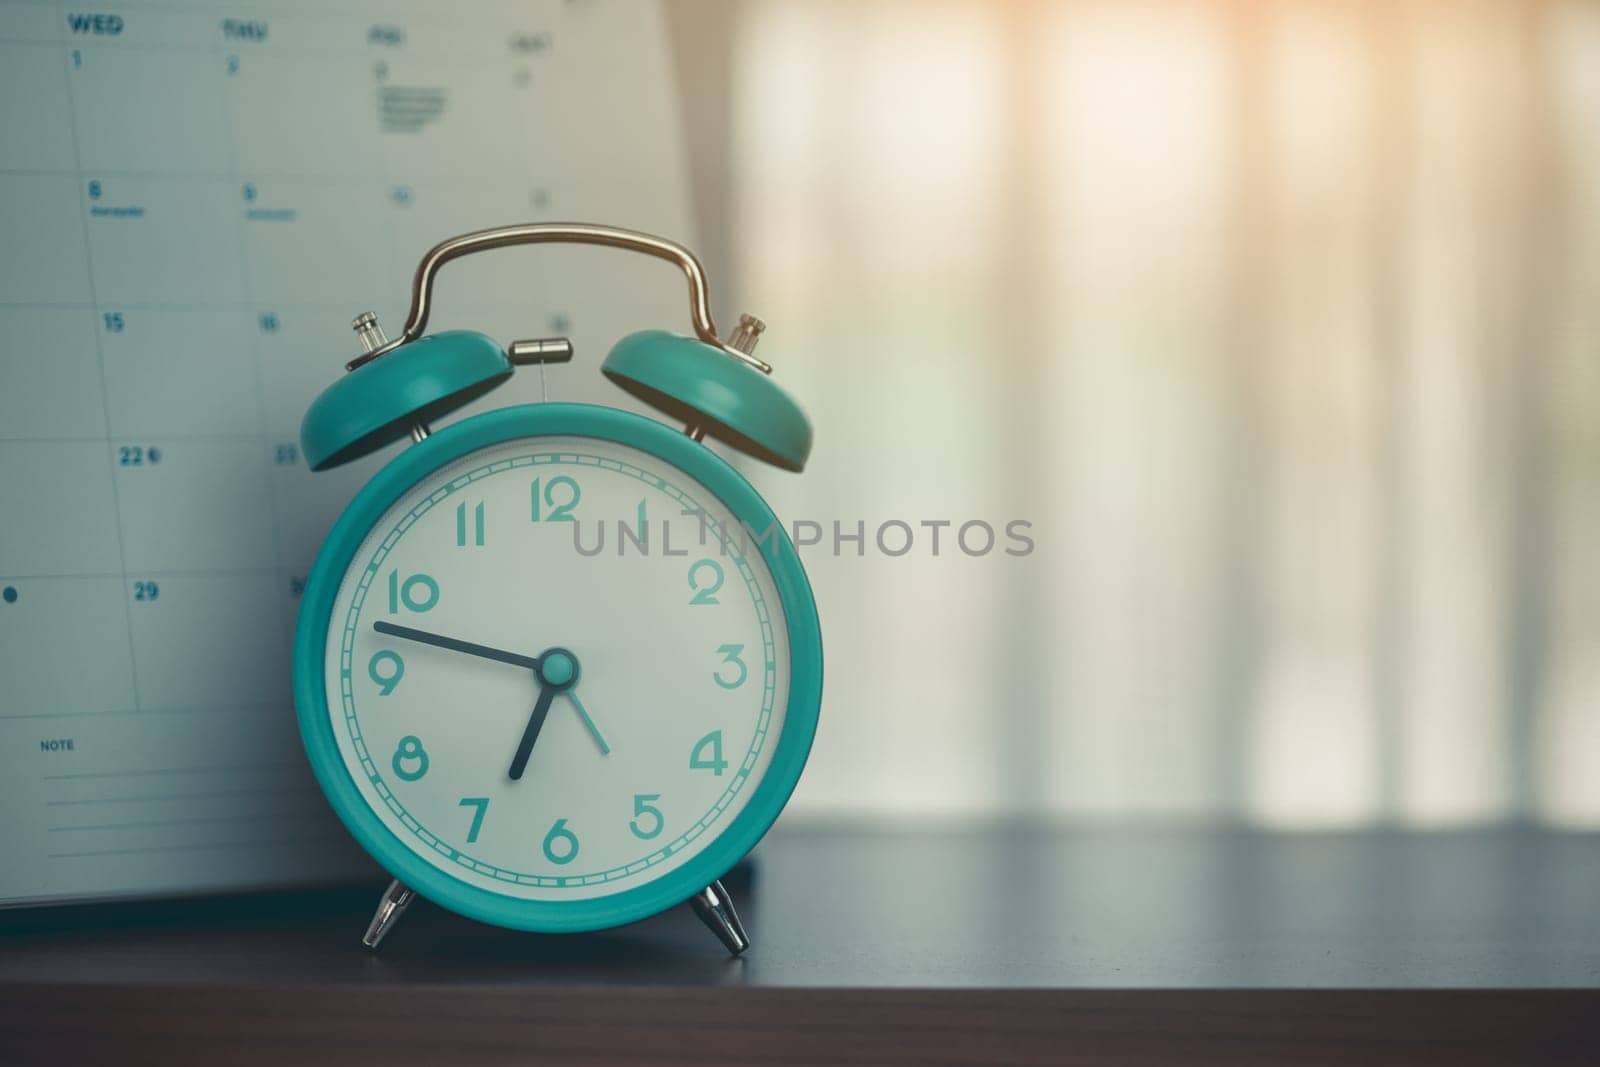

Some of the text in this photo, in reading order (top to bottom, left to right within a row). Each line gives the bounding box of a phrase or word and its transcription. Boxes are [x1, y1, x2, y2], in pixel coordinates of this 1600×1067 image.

[68, 14, 124, 35] WED
[89, 181, 102, 199] 8
[104, 313, 125, 332] 15
[120, 447, 143, 465] 22
[531, 476, 581, 522] 12
[637, 497, 647, 545] 1
[457, 501, 485, 546] 11
[135, 582, 159, 600] 29
[388, 567, 440, 614] 10
[688, 558, 725, 605] 2
[368, 649, 405, 696] 9
[713, 644, 748, 690] 3
[40, 739, 74, 752] NOTE
[392, 735, 430, 782] 8
[689, 730, 729, 776] 4
[458, 798, 490, 843] 7
[629, 794, 664, 840] 5
[543, 818, 580, 865] 6
